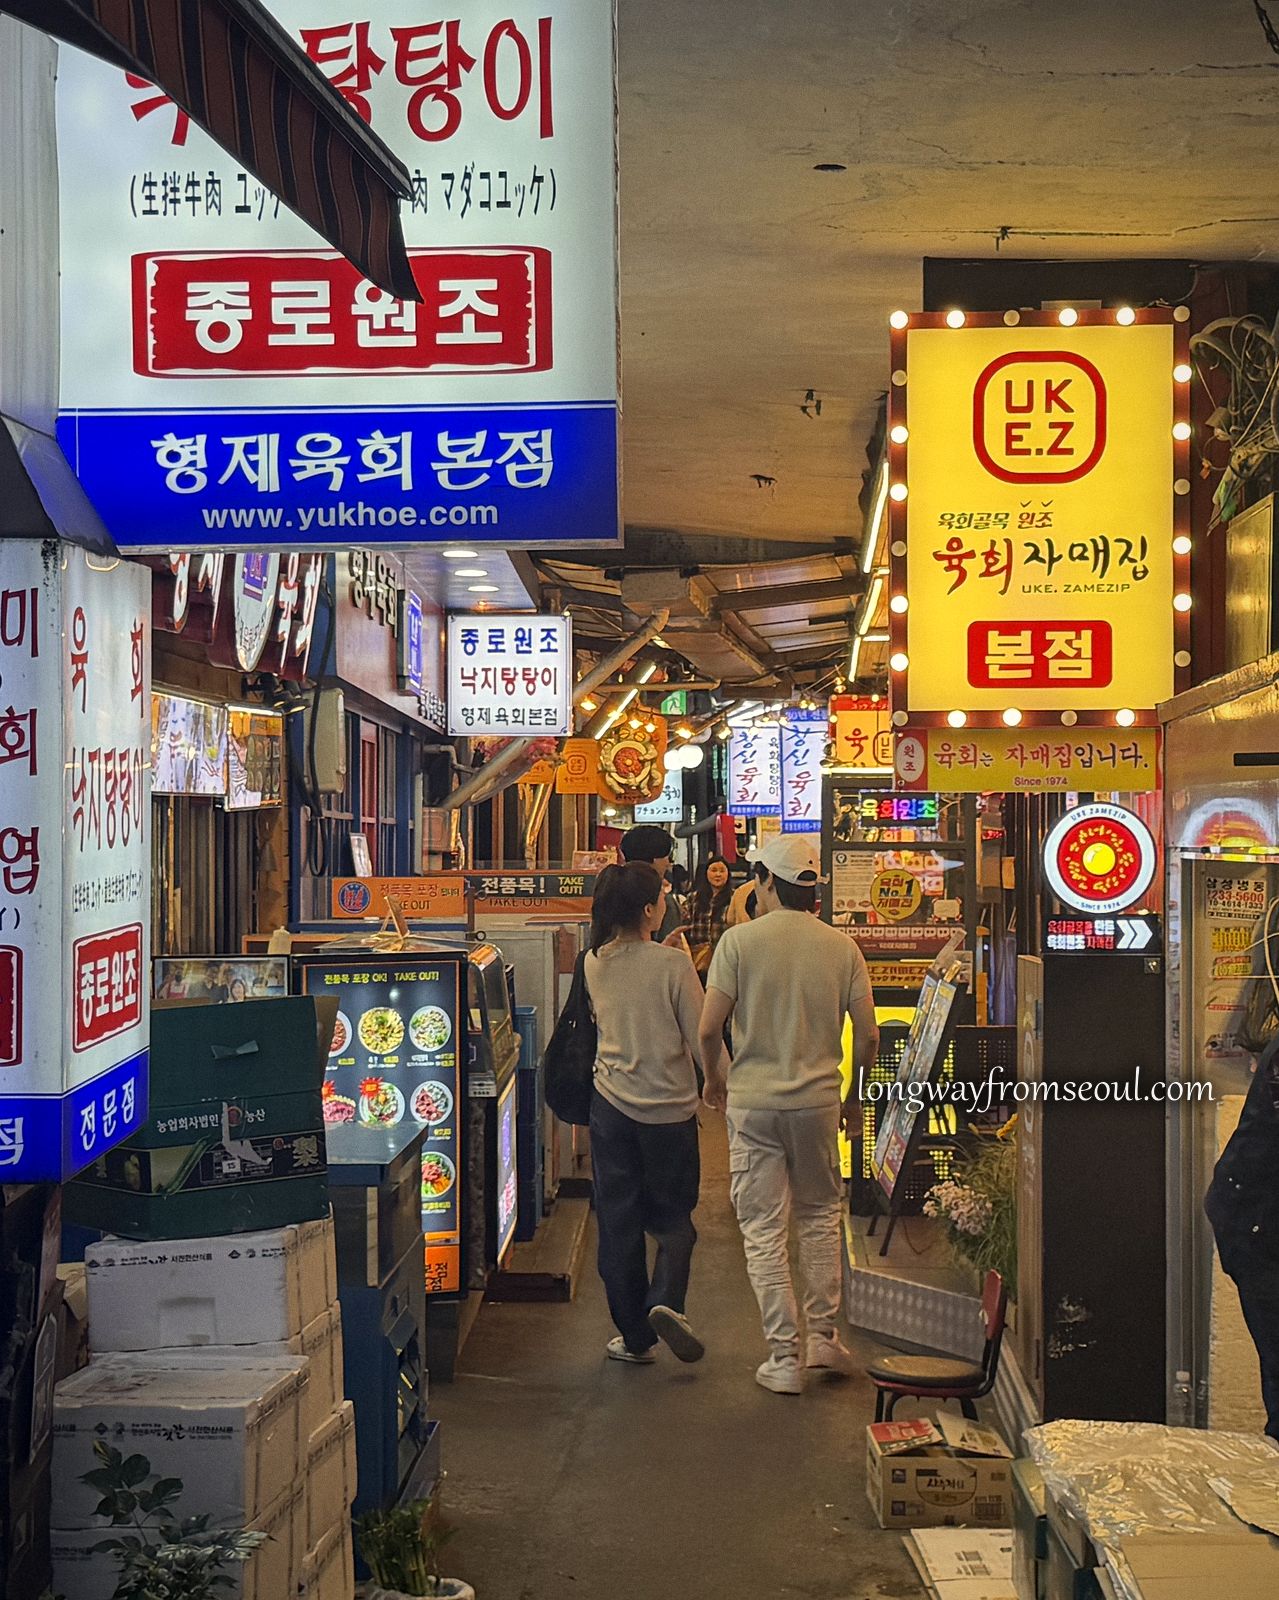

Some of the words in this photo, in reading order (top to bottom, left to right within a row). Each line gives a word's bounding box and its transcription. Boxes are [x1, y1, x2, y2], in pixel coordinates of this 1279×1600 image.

[185, 278, 503, 354] 종로원조
[1005, 379, 1074, 414] UK
[1005, 422, 1074, 456] E.Z
[150, 429, 413, 495] 형제육회
[430, 428, 555, 491] 본점
[202, 501, 499, 531] www.yukhoe.com
[938, 512, 1010, 530] 육회골목
[1017, 511, 1054, 530] 원조
[1022, 584, 1058, 594] UKE.
[1063, 583, 1131, 593] ZAMEZIP
[460, 627, 558, 656] 종로원조
[984, 629, 1093, 680] 본점
[460, 666, 557, 696] 낙지탕탕이
[934, 742, 994, 769] 육회는
[1004, 741, 1149, 770] 자매집입니다.
[1014, 776, 1042, 787] Since
[1046, 776, 1068, 786] 1974
[71, 746, 145, 853] 낙지탕탕이
[557, 876, 585, 886] TAKE
[410, 900, 431, 910] OUT
[80, 948, 137, 1029] 종로원조
[394, 971, 417, 982] TAKE
[80, 1076, 136, 1152] 전문점
